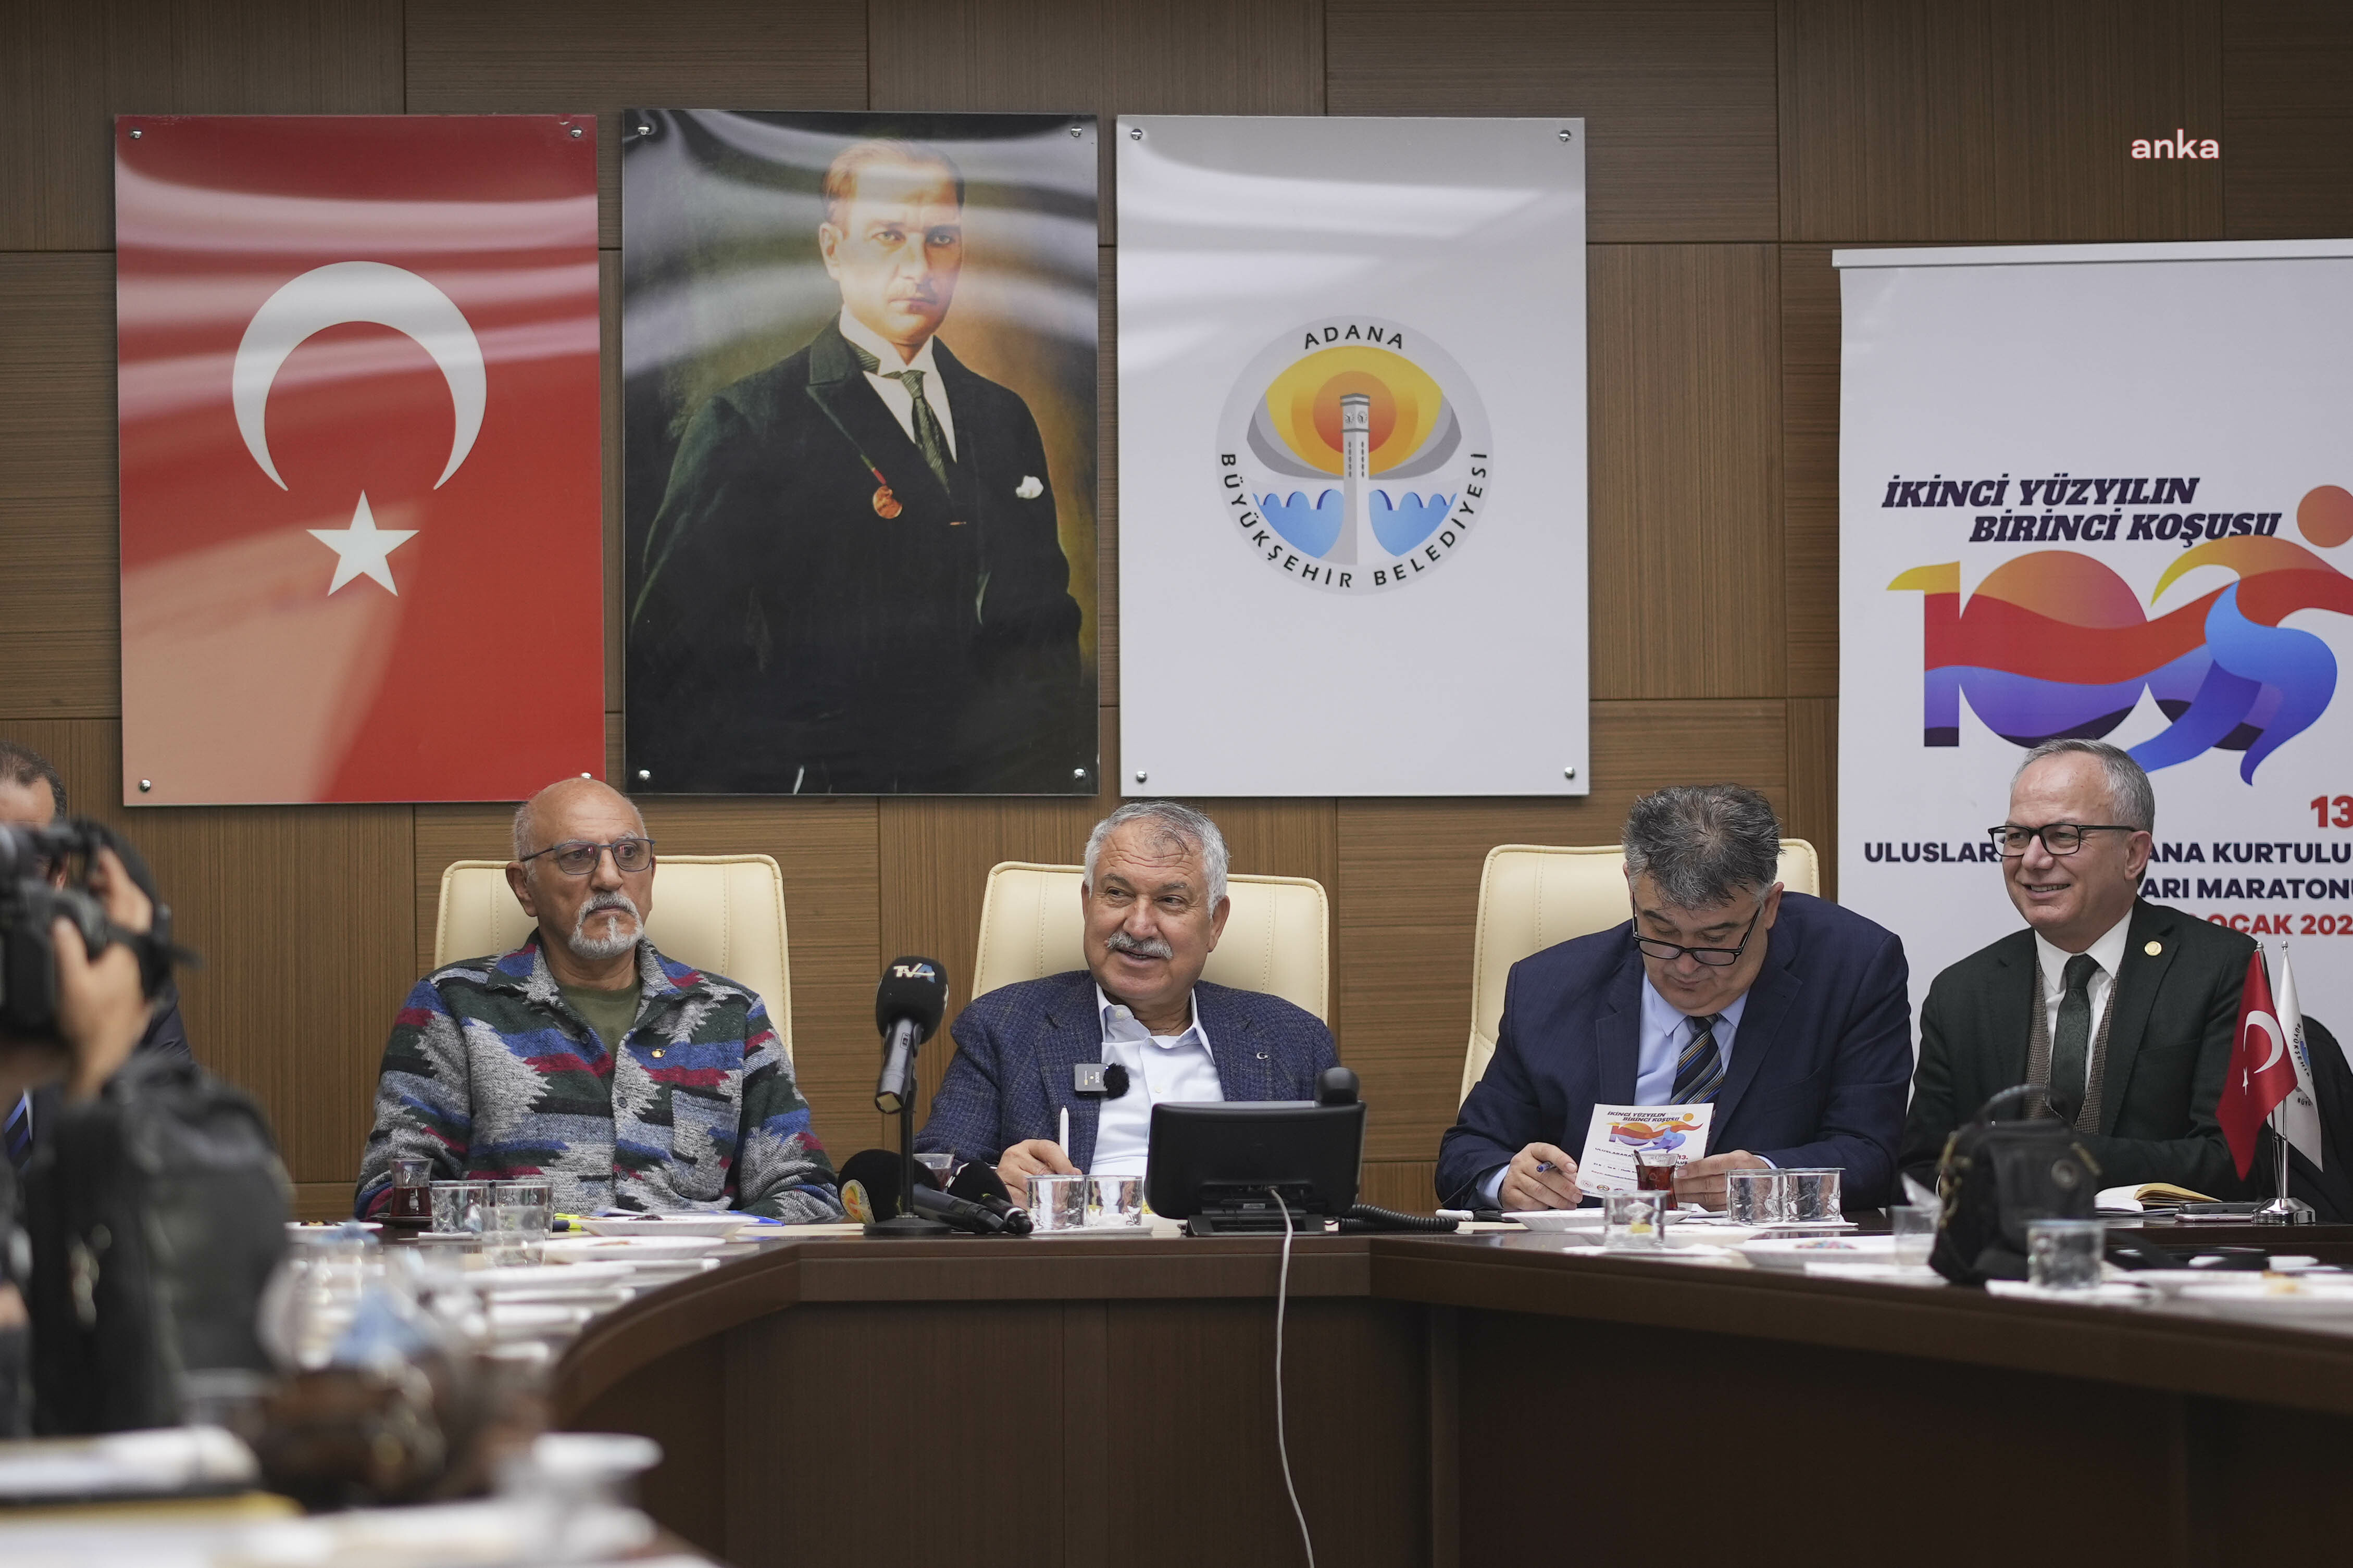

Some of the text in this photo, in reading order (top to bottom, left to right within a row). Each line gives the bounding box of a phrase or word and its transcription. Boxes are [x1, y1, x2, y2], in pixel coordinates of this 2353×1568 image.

[1305, 325, 1402, 349] ADANA
[1882, 473, 2200, 508] İKİNCİ YÜZYILIN
[1969, 508, 2283, 547] BİRİNCİ KOŞUSU
[1864, 842, 2353, 862] ULUSLAR ANA KURTULU
[2140, 878, 2353, 899] ARI MARATON
